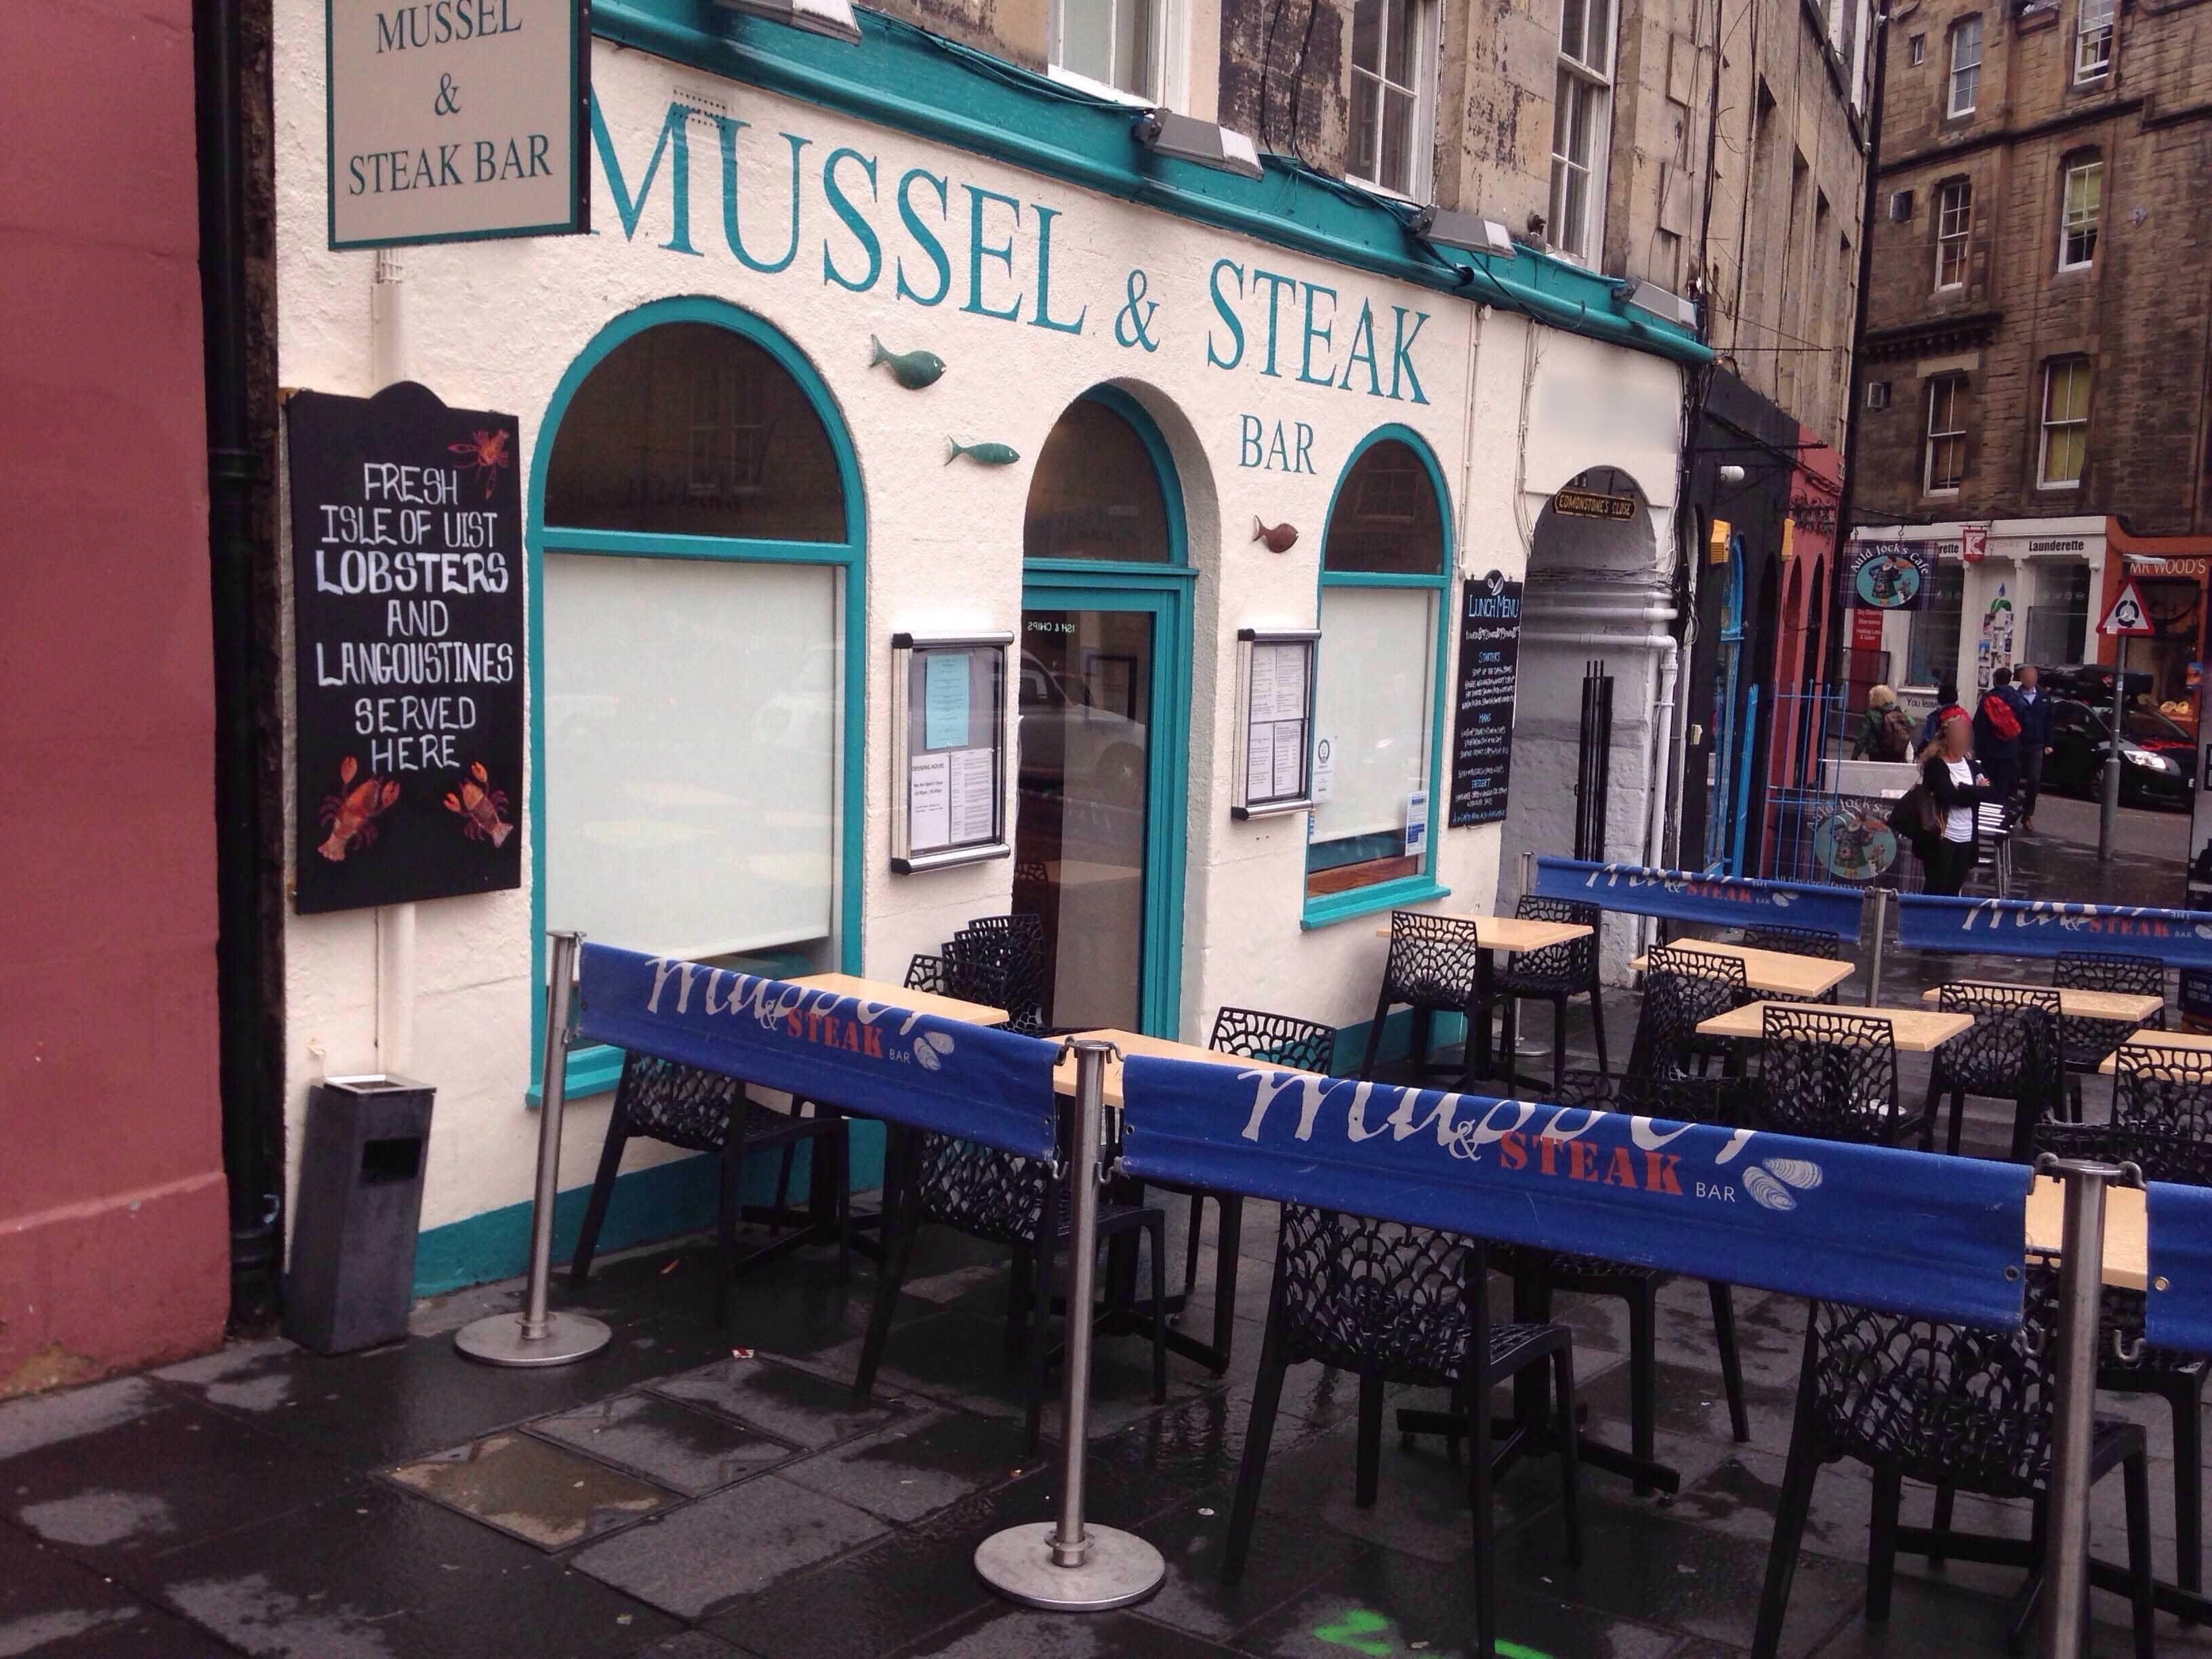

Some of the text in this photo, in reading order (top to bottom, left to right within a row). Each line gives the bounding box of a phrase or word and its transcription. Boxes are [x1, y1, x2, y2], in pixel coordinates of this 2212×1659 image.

[376, 0, 523, 54] MUSSEL
[434, 73, 462, 116] &
[349, 134, 553, 196] STEAK BAR
[590, 81, 1431, 405] MUSSEL & STEAK
[1238, 413, 1317, 474] BAR
[364, 462, 459, 506] FRESH
[1559, 495, 1633, 515] EDMONSTONE'S CLOSE
[320, 504, 498, 548] ISLE OF UIST
[2029, 539, 2085, 552] Launderette
[1850, 548, 1874, 573] Auld
[1876, 543, 1909, 556] Jock's
[1940, 544, 1959, 554] rette
[2154, 558, 2207, 574] WOOD'S
[316, 550, 509, 595] LOBSTERS
[386, 600, 449, 638] AND
[1469, 594, 1519, 618] LUNCH MENU
[316, 641, 513, 687] LANGOUSTINES
[355, 696, 476, 735] SERVED
[1906, 697, 1921, 707] You
[371, 734, 461, 773] HERE
[1839, 798, 1883, 813] Jock's
[1685, 882, 1753, 903] STEAK
[2088, 918, 2169, 938] STEAK
[2174, 930, 2192, 939] BAR
[760, 999, 910, 1064] & STEAK BAR
[1448, 1119, 1736, 1203] & STEAK BAR
